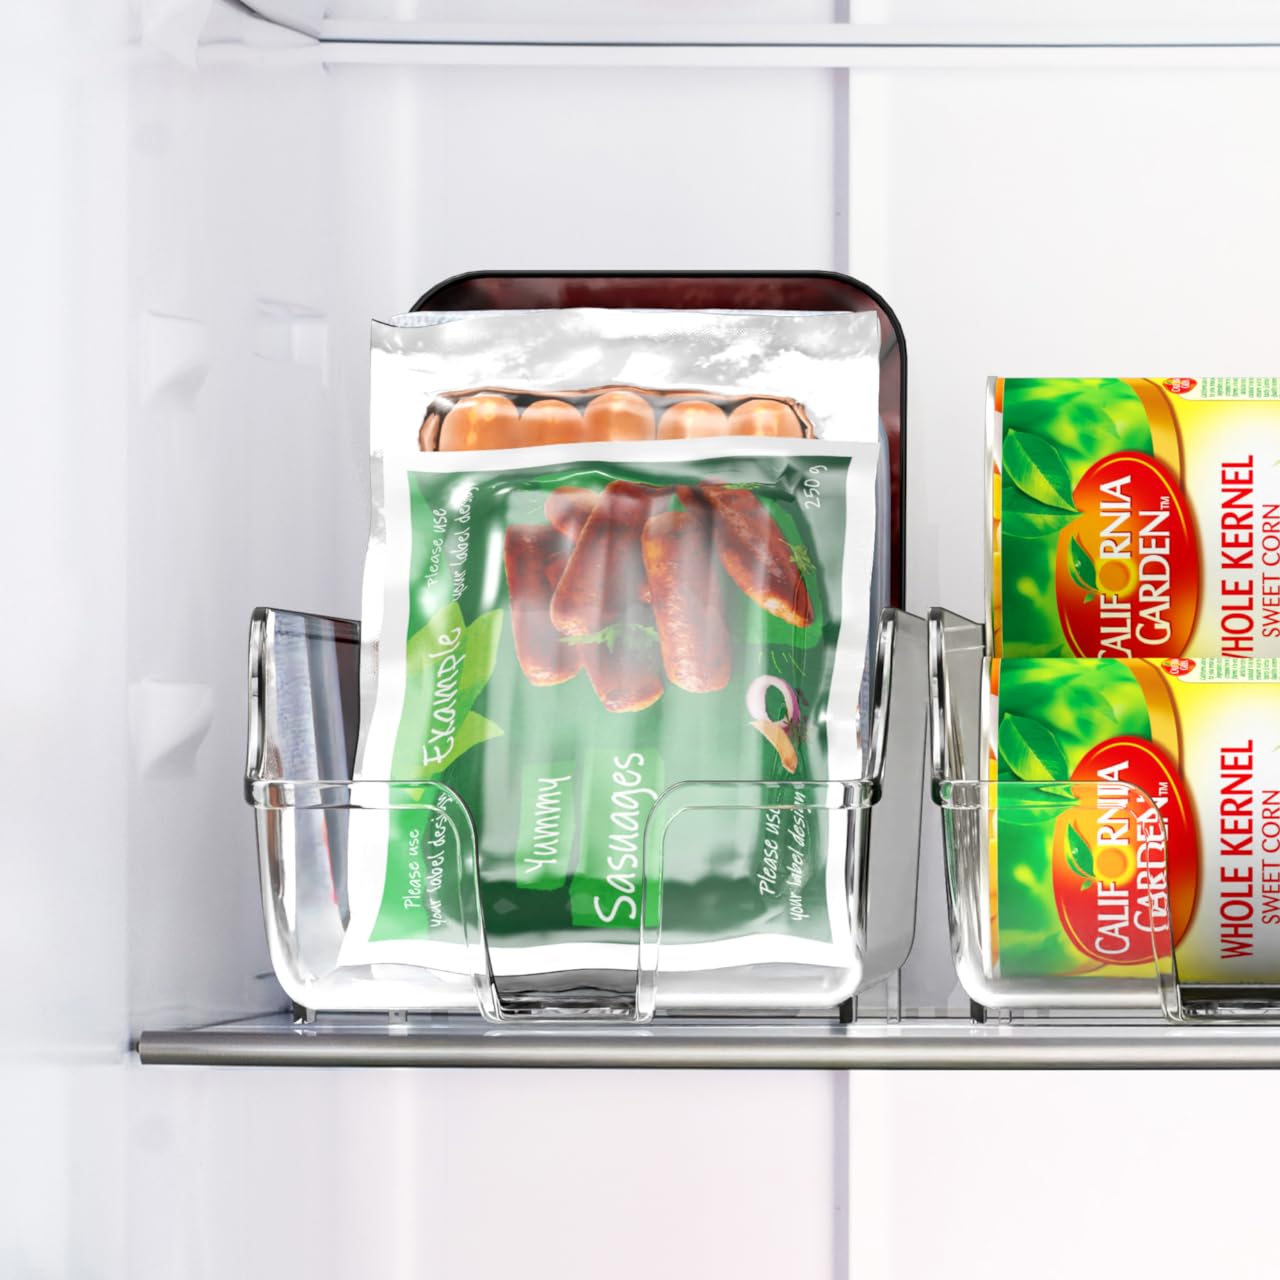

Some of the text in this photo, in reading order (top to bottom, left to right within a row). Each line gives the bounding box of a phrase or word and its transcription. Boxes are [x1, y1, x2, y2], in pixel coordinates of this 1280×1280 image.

[803, 464, 828, 510] 250 g
[424, 507, 448, 590] Please use
[448, 526, 471, 568] label
[1221, 454, 1254, 658] HOLE KERNEL
[422, 626, 467, 768] Example
[523, 775, 572, 874] Yummy
[592, 751, 659, 923] Sasuages
[1219, 739, 1255, 959] WHOLE KERNEL
[402, 829, 422, 910] Please use
[426, 850, 445, 894] label
[756, 838, 779, 896] Please
[785, 845, 805, 887] label
[427, 898, 447, 928] your
[787, 890, 810, 921] your
